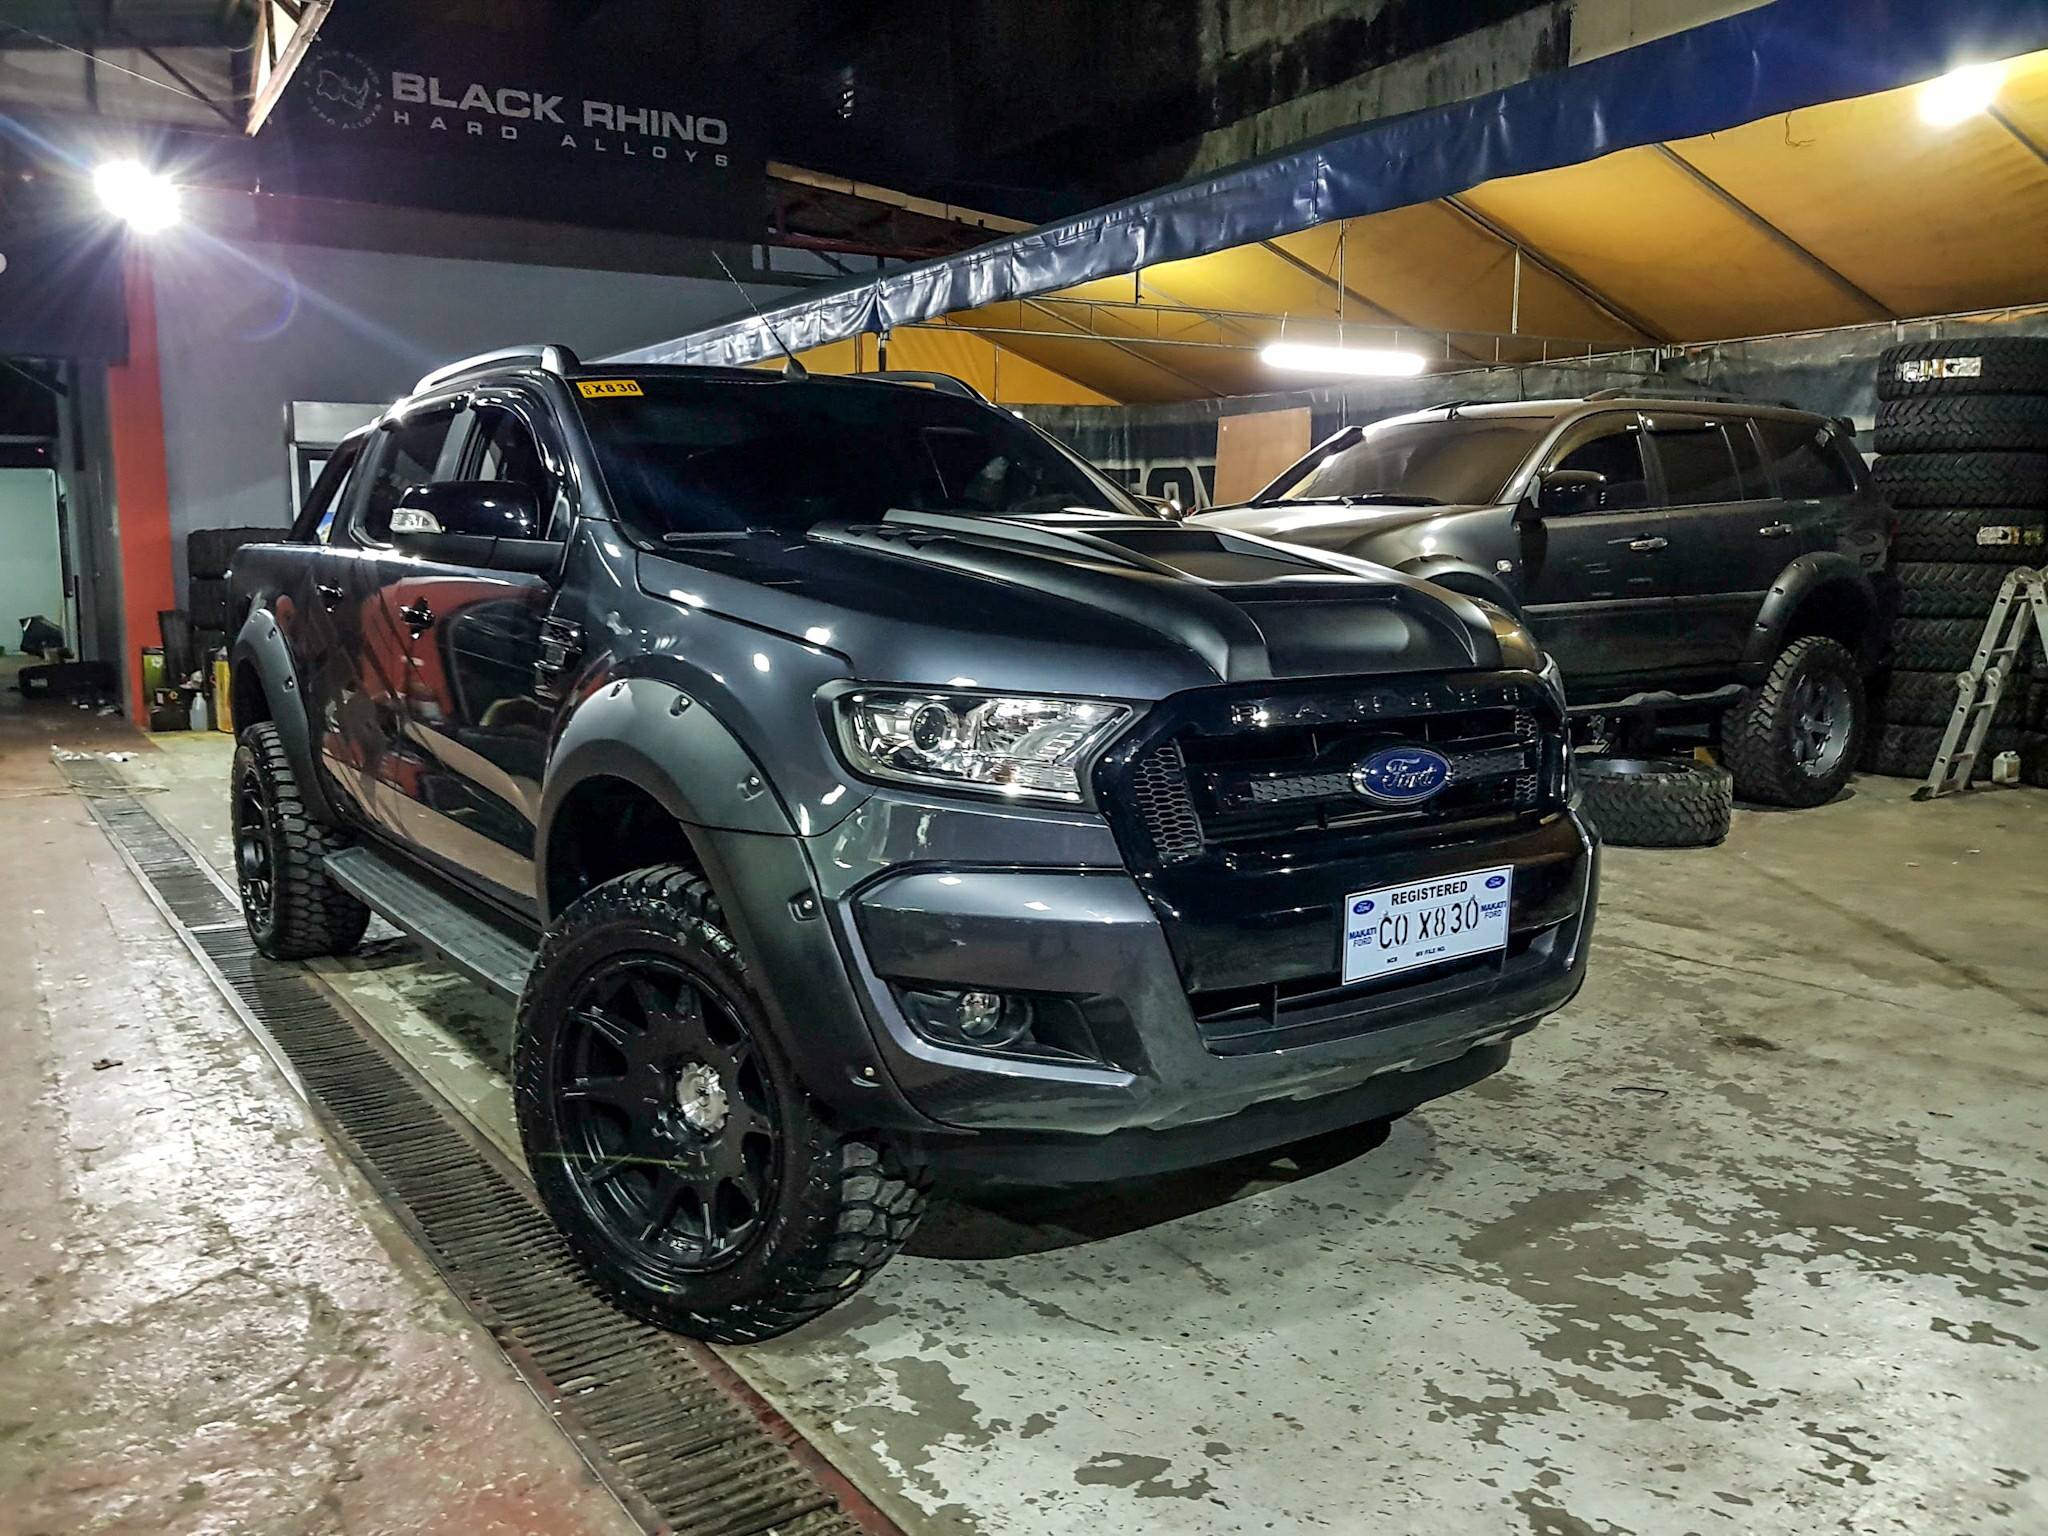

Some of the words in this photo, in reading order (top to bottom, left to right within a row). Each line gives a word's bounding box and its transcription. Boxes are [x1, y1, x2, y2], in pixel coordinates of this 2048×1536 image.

[392, 71, 564, 124] BLACK
[583, 100, 728, 146] RHINO
[393, 110, 518, 140] HARD
[560, 133, 728, 168] ALLOYS
[1381, 756, 1438, 790] Ford
[1391, 880, 1468, 906] REGISTERED
[1480, 901, 1507, 912] MAKATI
[1349, 927, 1377, 939] MAKATI
[1418, 898, 1478, 939] X830
[1353, 937, 1373, 947] FORD
